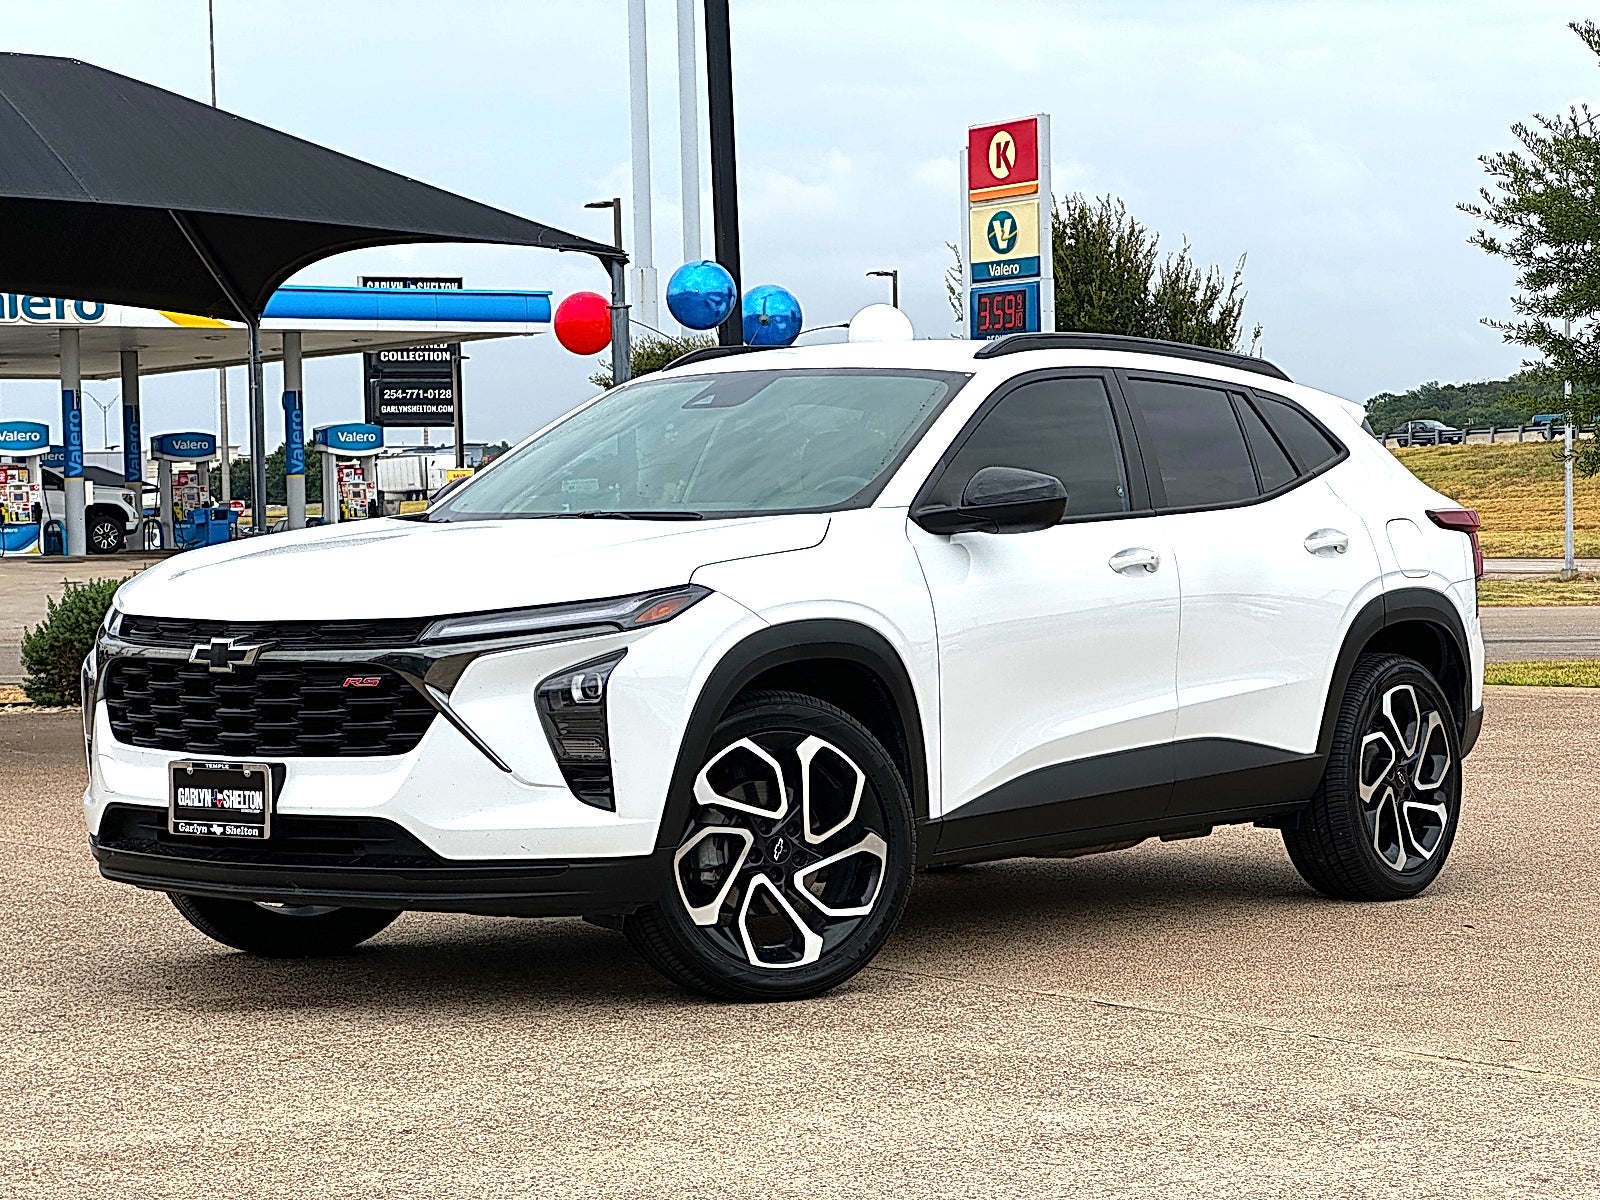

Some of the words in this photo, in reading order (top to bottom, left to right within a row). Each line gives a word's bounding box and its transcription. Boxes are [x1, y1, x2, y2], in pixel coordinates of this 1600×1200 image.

[996, 140, 1014, 169] K
[989, 263, 1019, 277] Valero
[979, 294, 1016, 331] 3.59
[380, 351, 451, 361] COLLECTION
[383, 389, 453, 399] 254-771-0128
[381, 405, 454, 413] GARLYNSHELTON.COM
[69, 410, 83, 477] Valero
[290, 410, 304, 473] Valero
[337, 431, 377, 442] Valero
[128, 423, 141, 481] Valero
[172, 440, 209, 450] Valero
[343, 676, 382, 687] RS
[178, 787, 212, 807] GARLYN
[223, 789, 263, 809] SHELTON
[178, 822, 208, 835] Garlyn
[225, 825, 259, 836] Shelton
